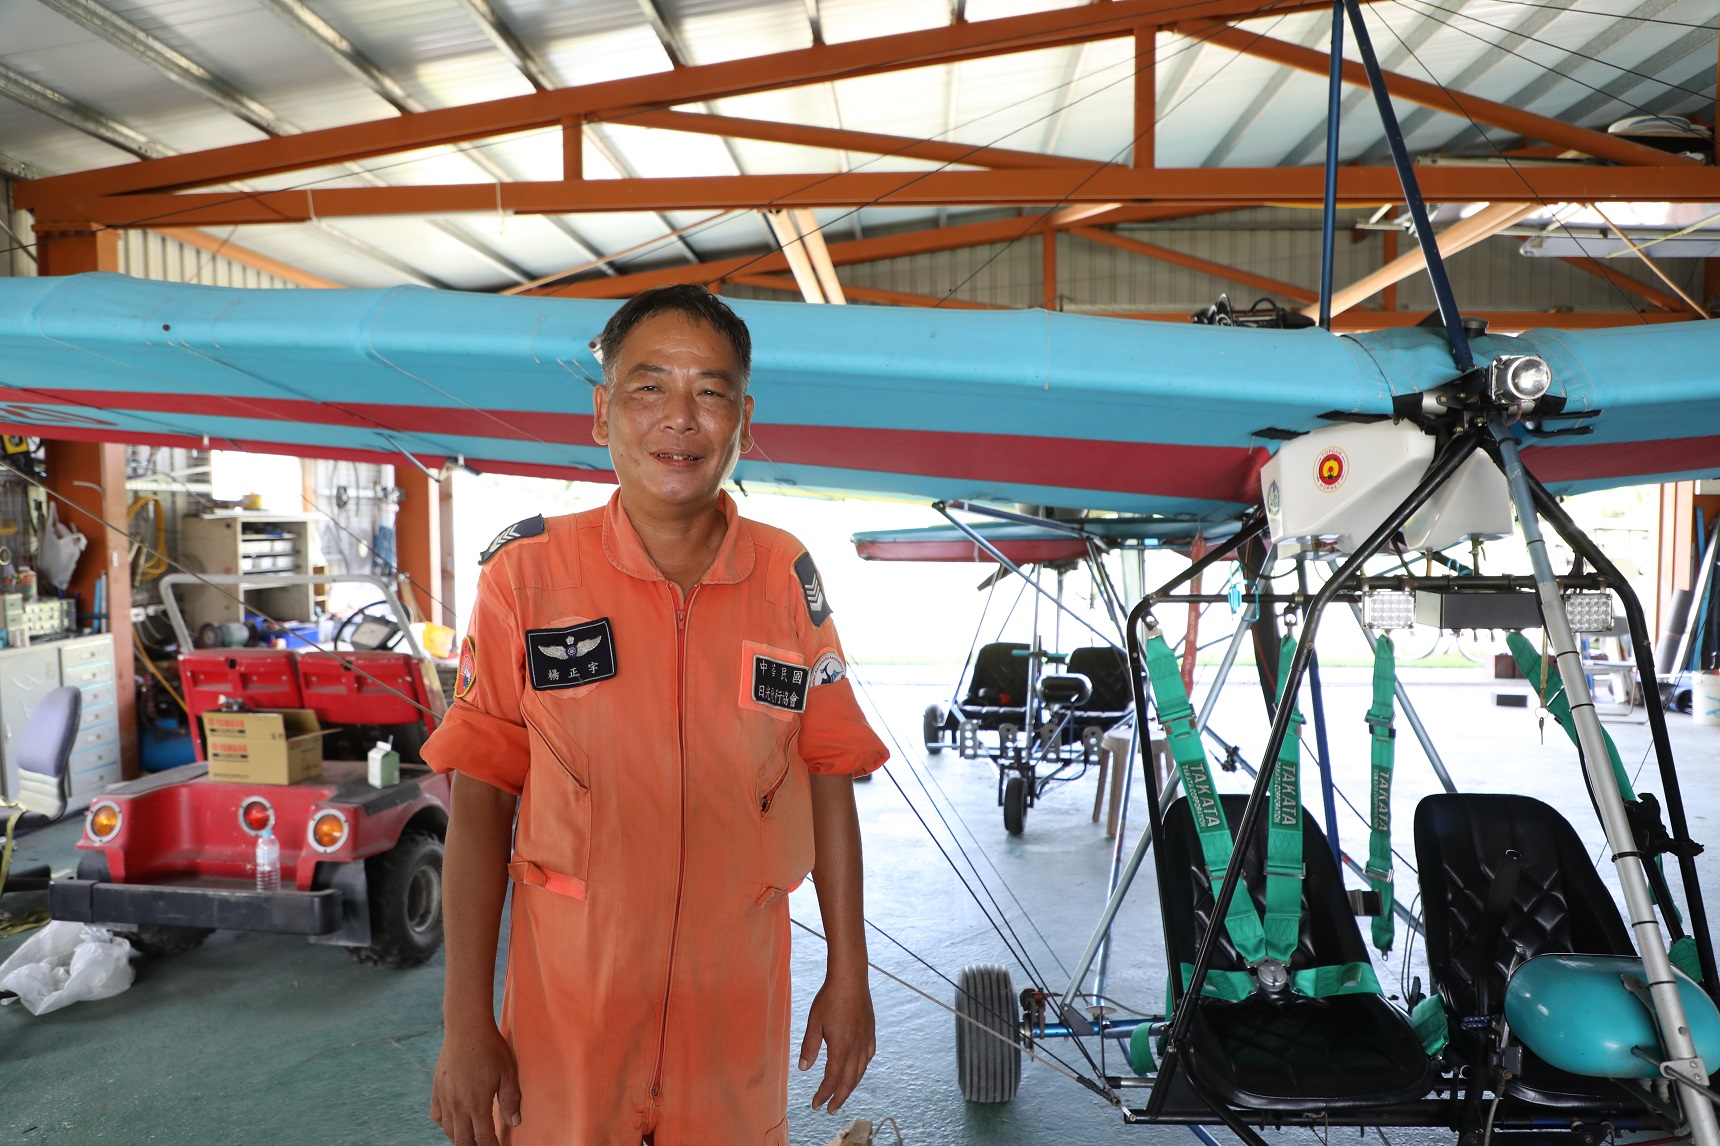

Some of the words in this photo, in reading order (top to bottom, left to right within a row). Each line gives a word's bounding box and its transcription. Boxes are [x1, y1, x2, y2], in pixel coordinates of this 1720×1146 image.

[1182, 764, 1194, 788] TAKATA
[1189, 787, 1206, 827] CORPORATION
[1190, 763, 1221, 827] TAKATA
[1282, 765, 1297, 825] TAKATA
[1379, 771, 1390, 831] TAKATA
